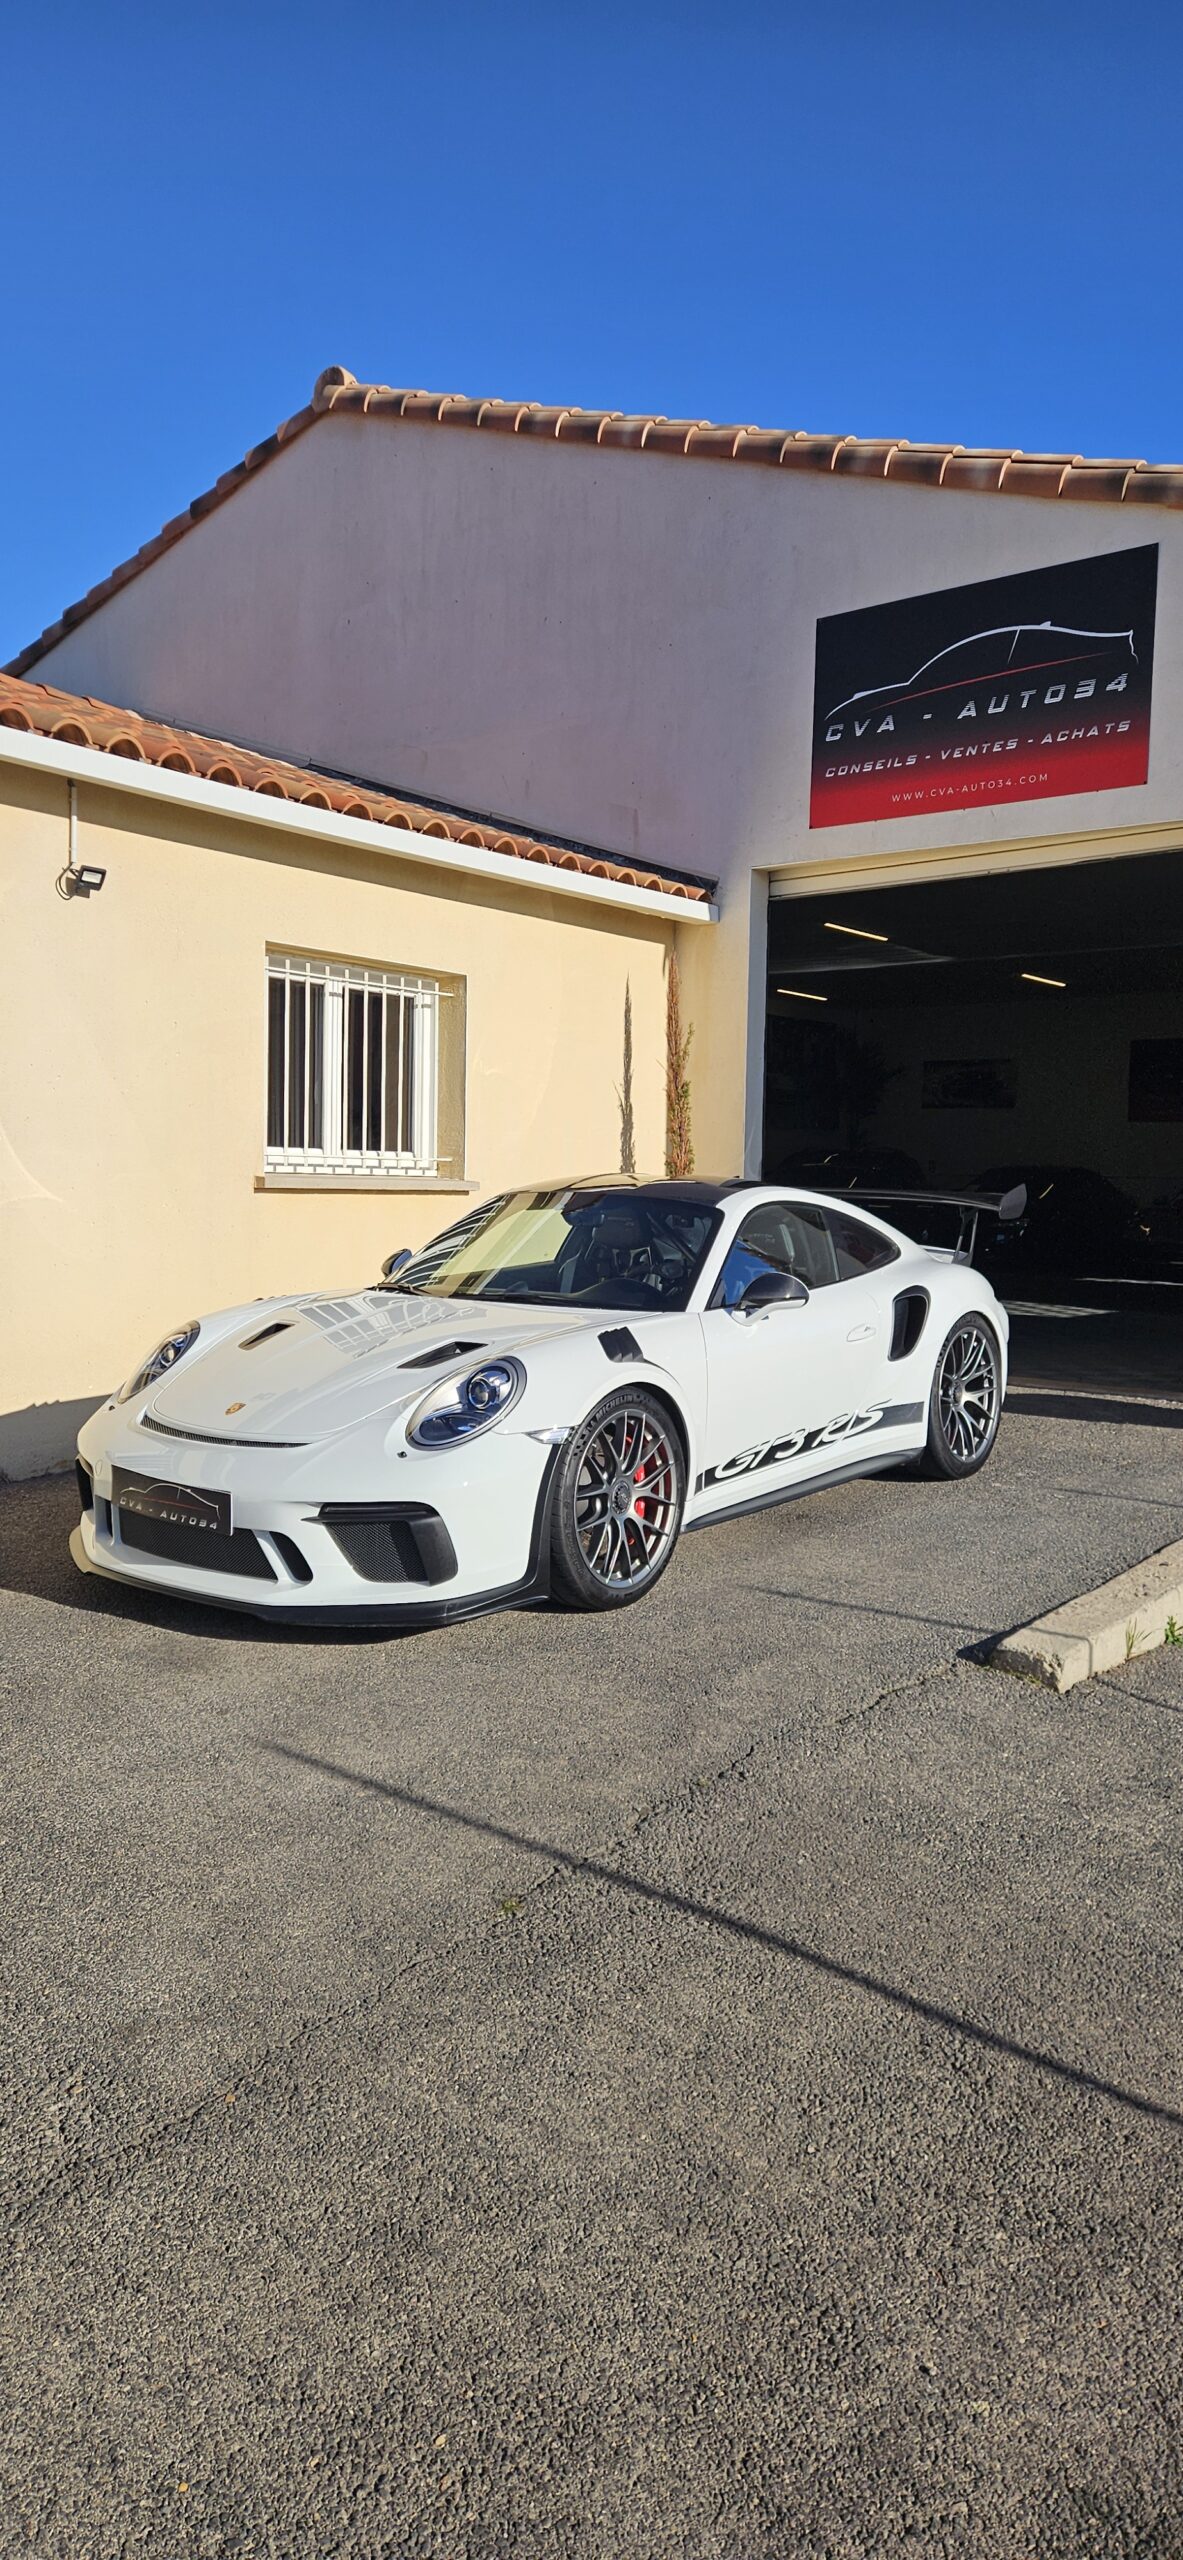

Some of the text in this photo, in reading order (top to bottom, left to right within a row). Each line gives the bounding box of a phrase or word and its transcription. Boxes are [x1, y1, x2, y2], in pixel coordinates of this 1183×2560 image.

[825, 714, 895, 742] CVA
[957, 672, 1129, 719] AUTO34
[825, 754, 918, 778] CONSEILS
[941, 738, 1018, 760] VENTES
[1040, 719, 1131, 745] ACHATS
[891, 773, 1049, 802] WWW.CVA-AUTO34.COM
[714, 1398, 893, 1480] GT3 RS
[119, 1497, 142, 1511] CVA
[160, 1510, 218, 1530] AUTO34
